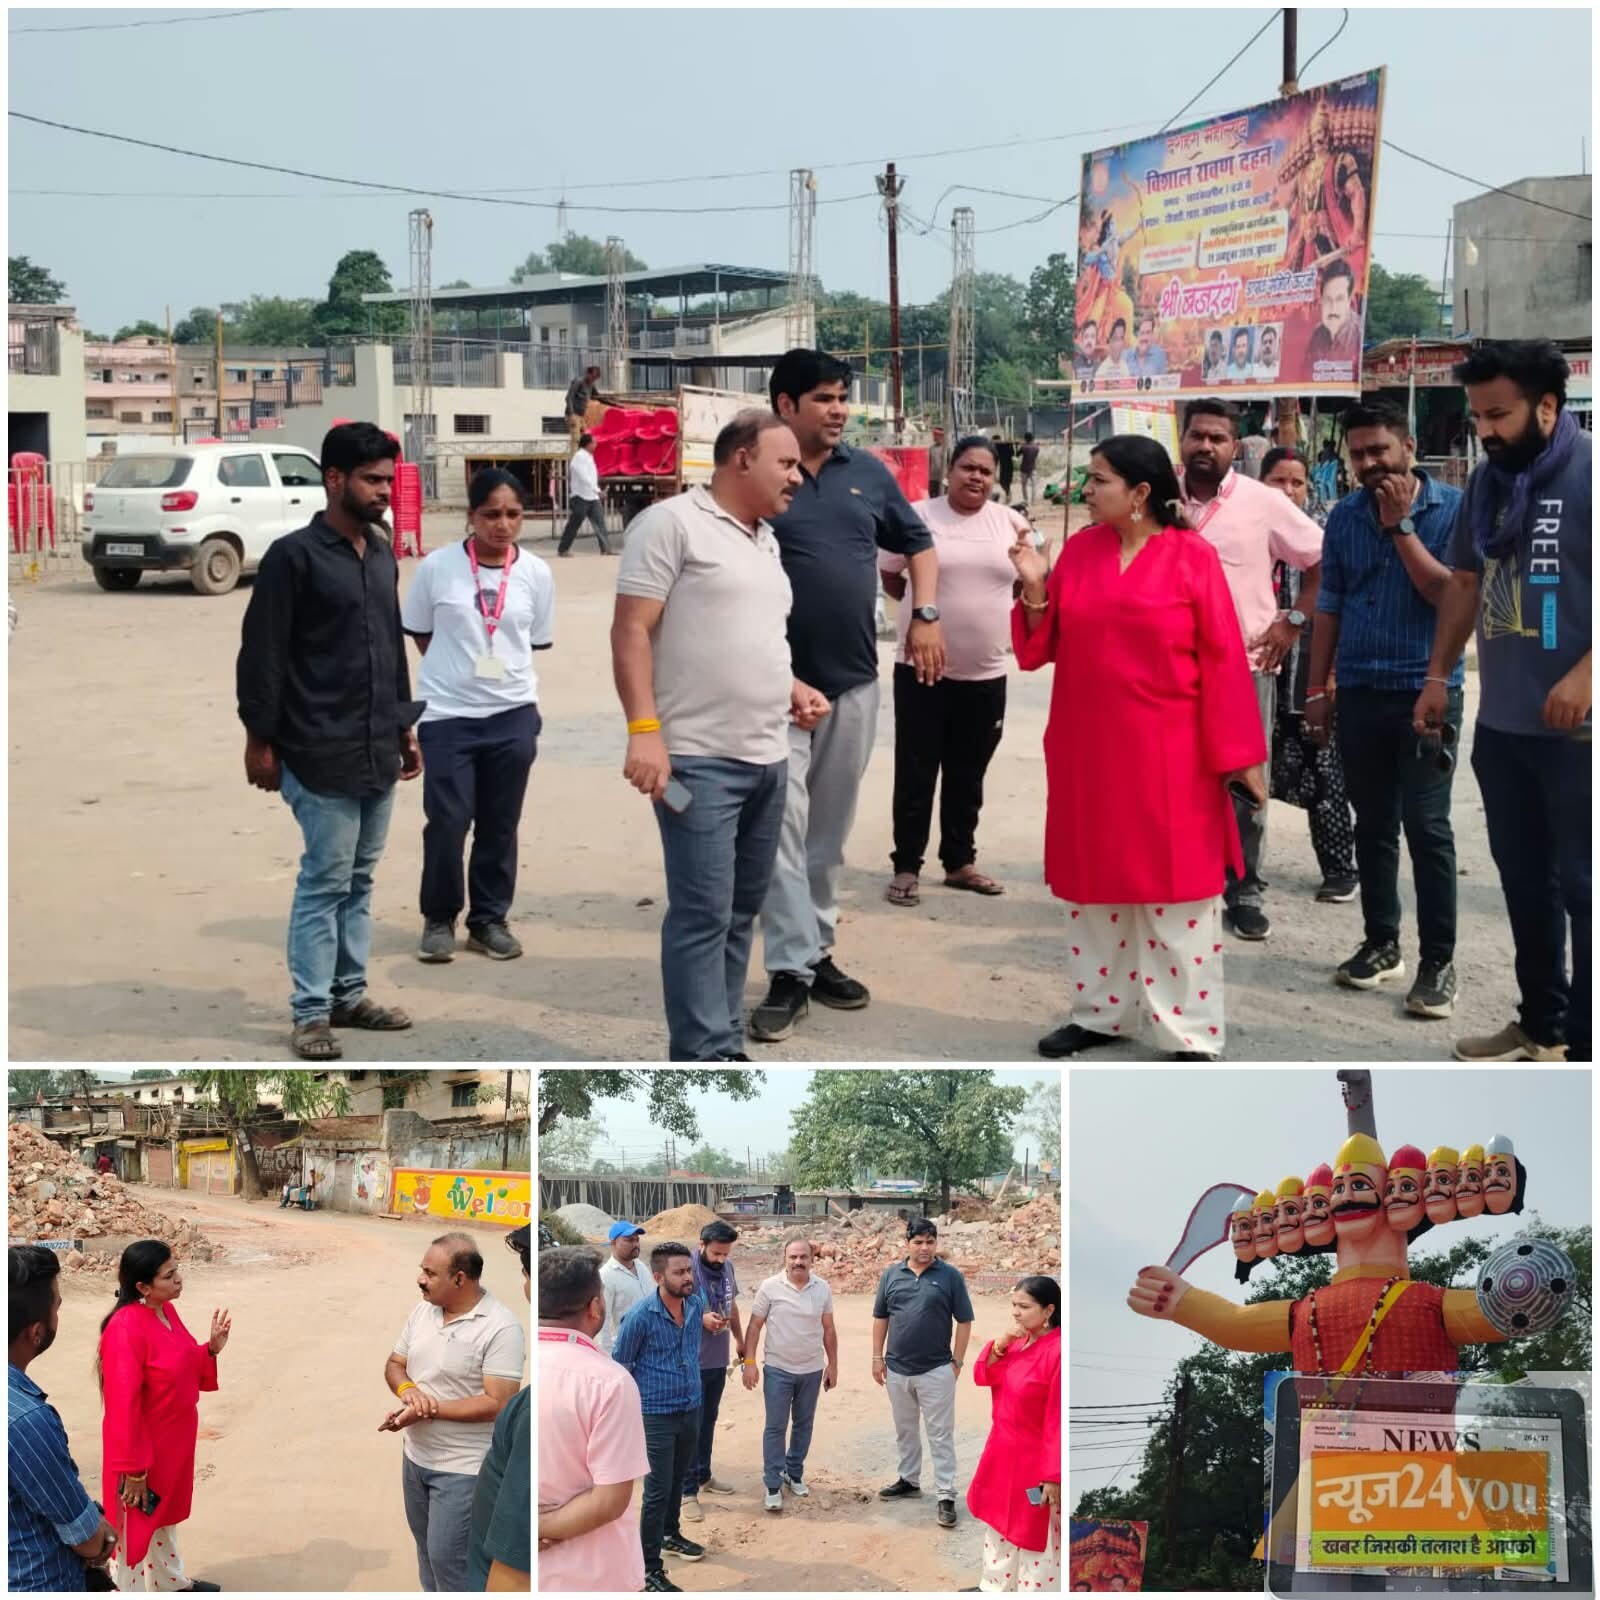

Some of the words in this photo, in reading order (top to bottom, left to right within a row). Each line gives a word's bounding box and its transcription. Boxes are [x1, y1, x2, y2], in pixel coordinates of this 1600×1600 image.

[1146, 166, 1192, 194] विशाल
[1197, 156, 1233, 182] रावण
[1239, 146, 1273, 172] दहन
[1161, 278, 1179, 316] श्री
[1530, 499, 1563, 573] FREE
